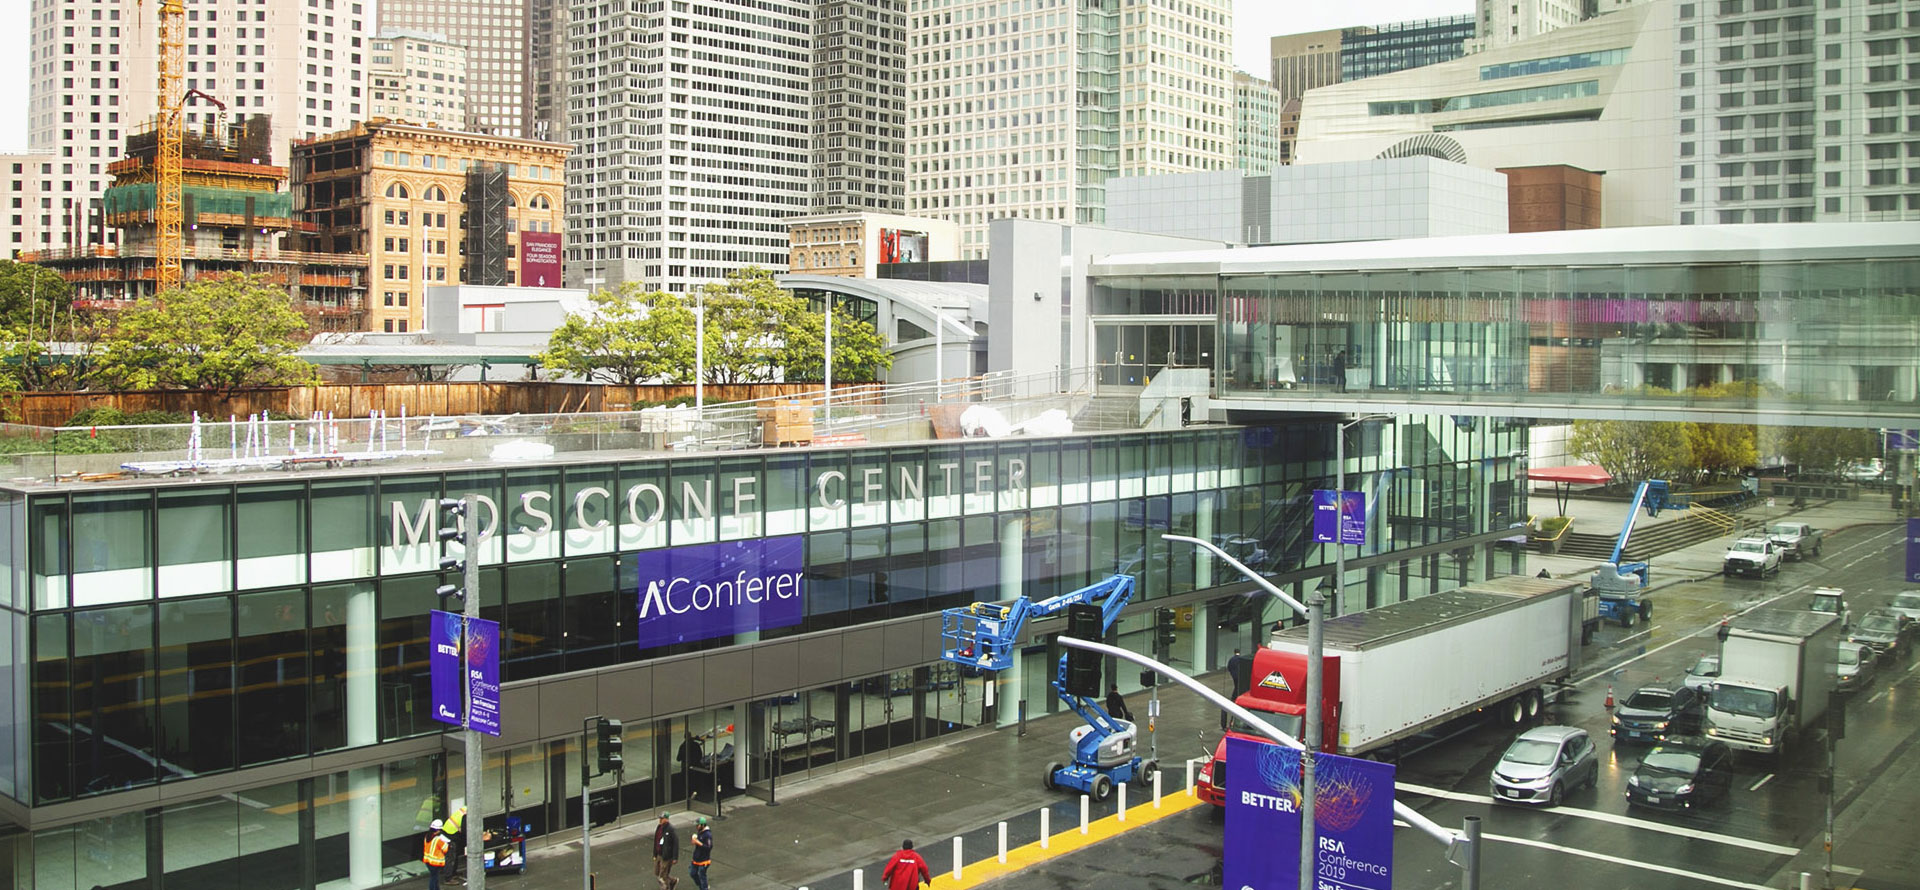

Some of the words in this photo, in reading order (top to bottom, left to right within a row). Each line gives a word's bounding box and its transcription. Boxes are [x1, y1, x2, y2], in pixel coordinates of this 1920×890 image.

[390, 476, 757, 551] MOSCONE
[816, 458, 1026, 511] CENTER
[470, 670, 483, 680] RSA
[1242, 790, 1296, 813] BETTER.
[1319, 836, 1345, 854] RSA
[1318, 850, 1388, 876] Conference
[1318, 862, 1346, 880] 2019
